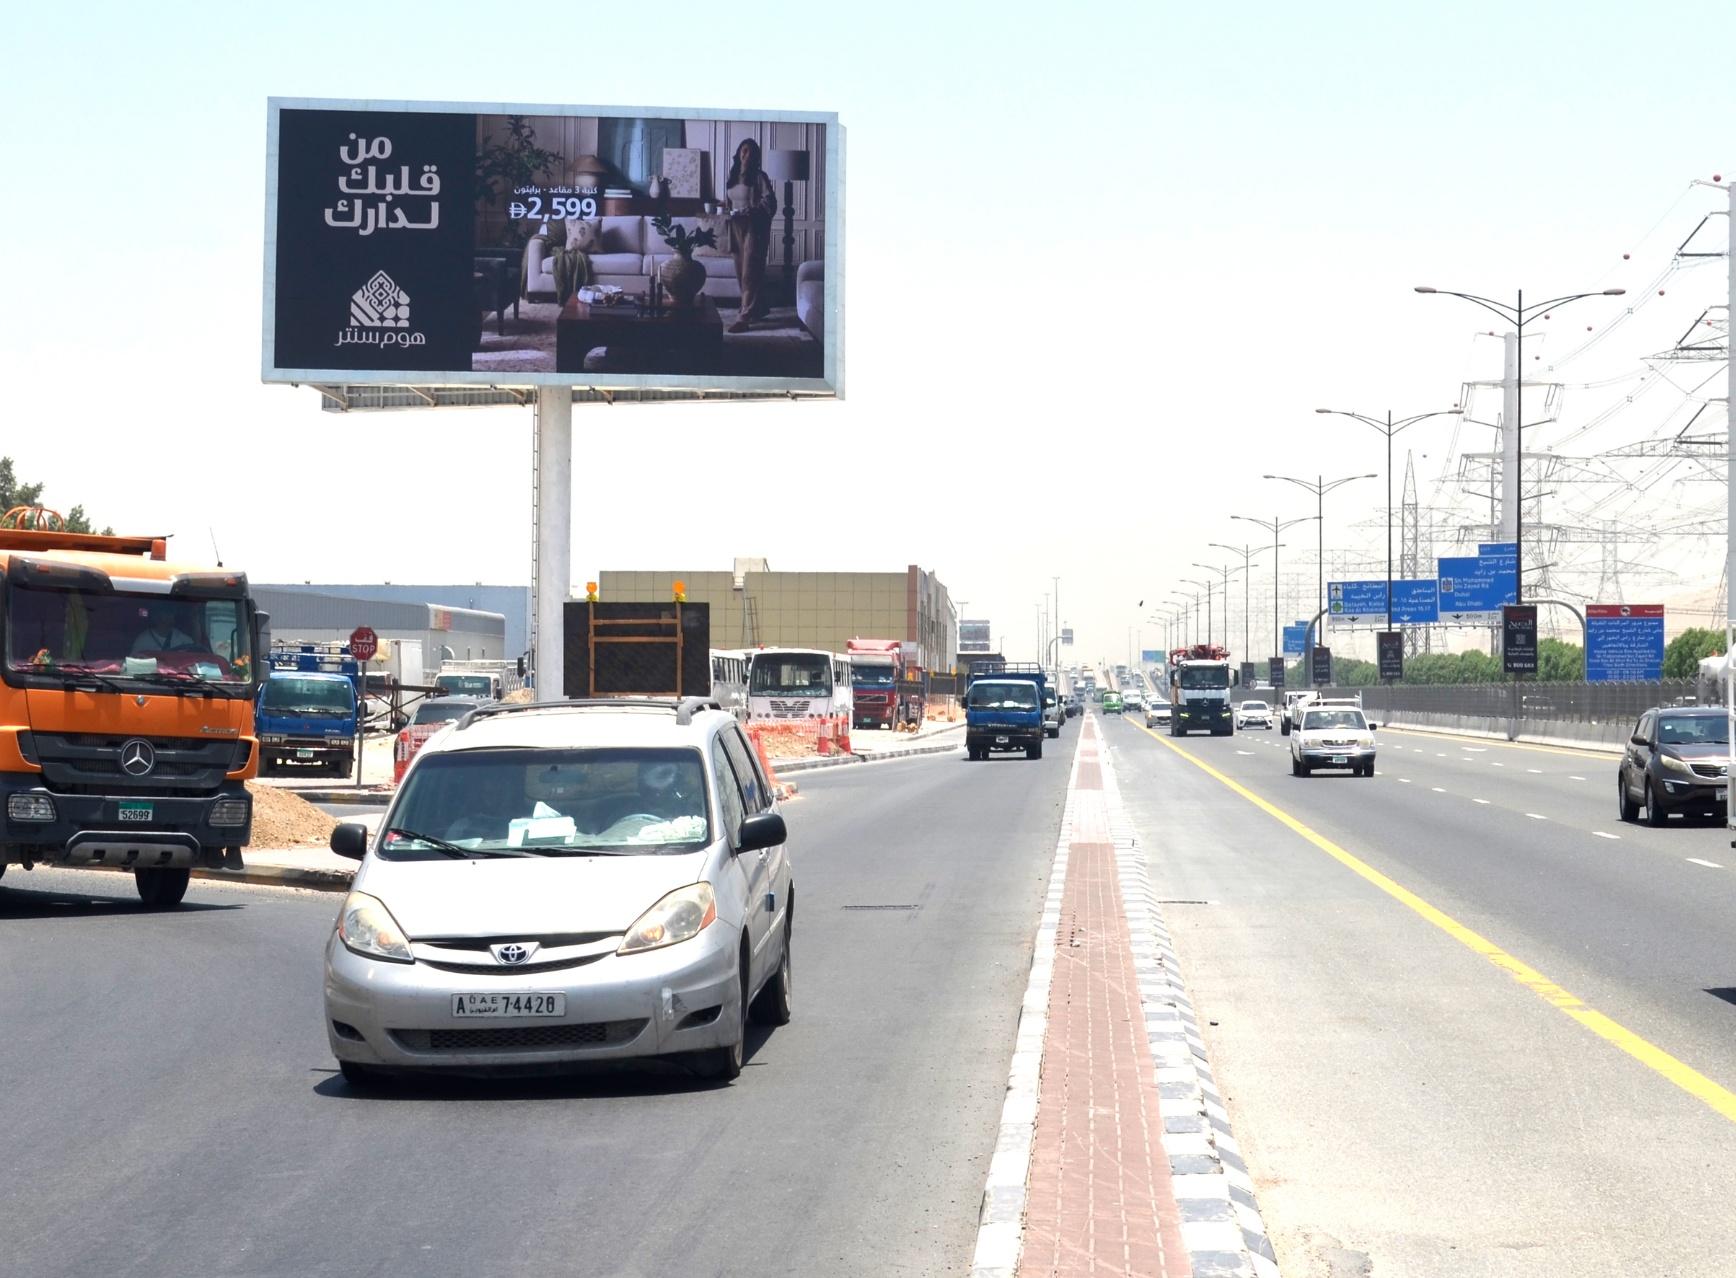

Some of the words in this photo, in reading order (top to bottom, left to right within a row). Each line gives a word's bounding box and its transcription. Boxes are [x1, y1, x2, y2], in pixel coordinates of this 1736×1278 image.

[339, 132, 393, 165] من
[338, 165, 441, 201] قلبك
[324, 199, 440, 236] لدارك
[333, 327, 380, 347] سنتر
[381, 332, 426, 349] هوم
[351, 643, 375, 655] STOP
[122, 810, 150, 820] 52699
[456, 996, 465, 1014] A
